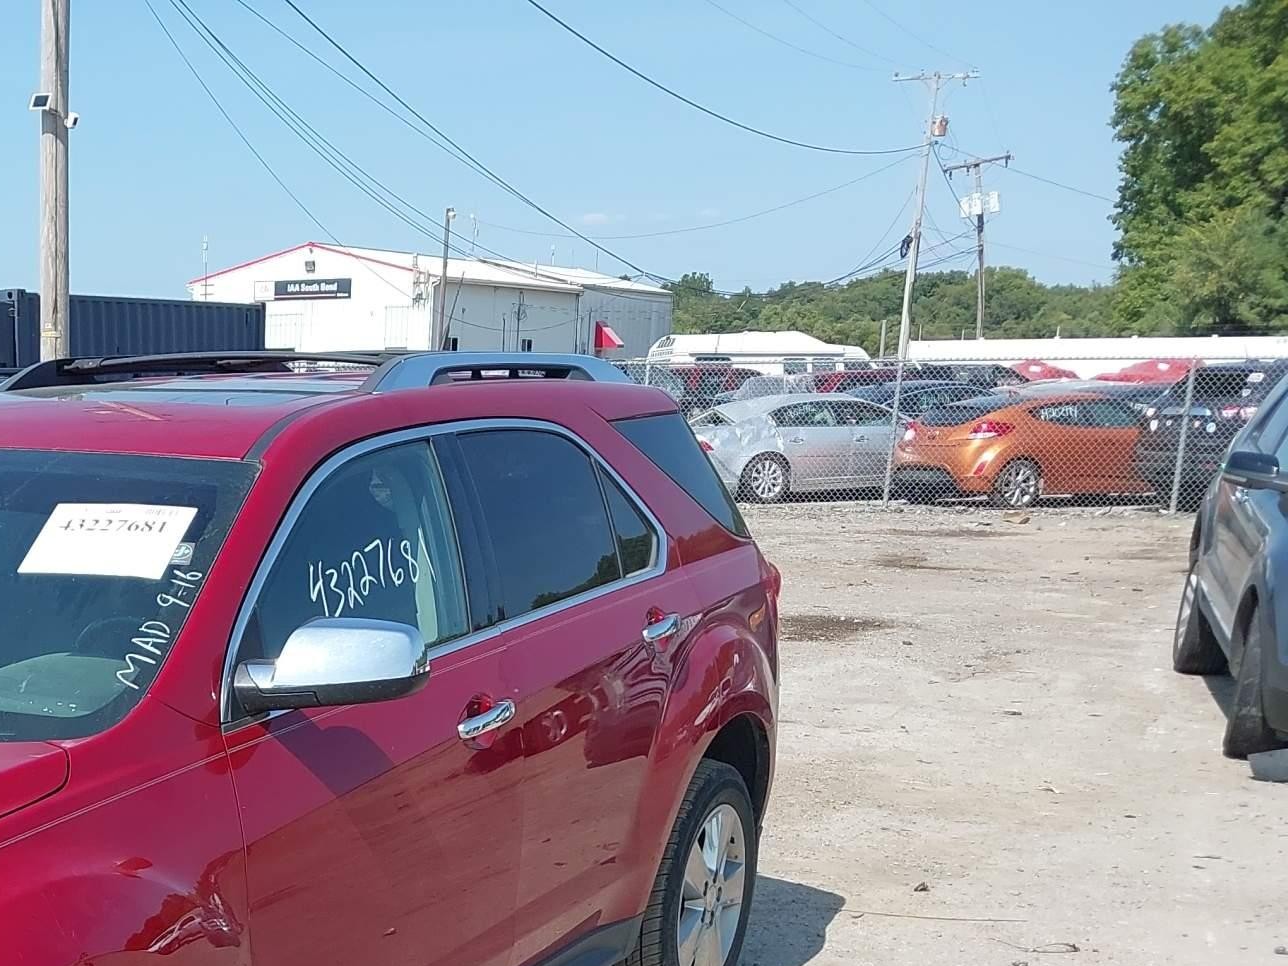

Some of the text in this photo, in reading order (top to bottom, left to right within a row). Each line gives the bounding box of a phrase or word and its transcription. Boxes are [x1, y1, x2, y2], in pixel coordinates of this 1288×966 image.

[287, 281, 338, 292] IAA South Bend
[59, 518, 169, 534] 43227681
[308, 526, 437, 618] 43227681
[116, 620, 171, 691] MAD
[156, 568, 203, 608] 9-16
